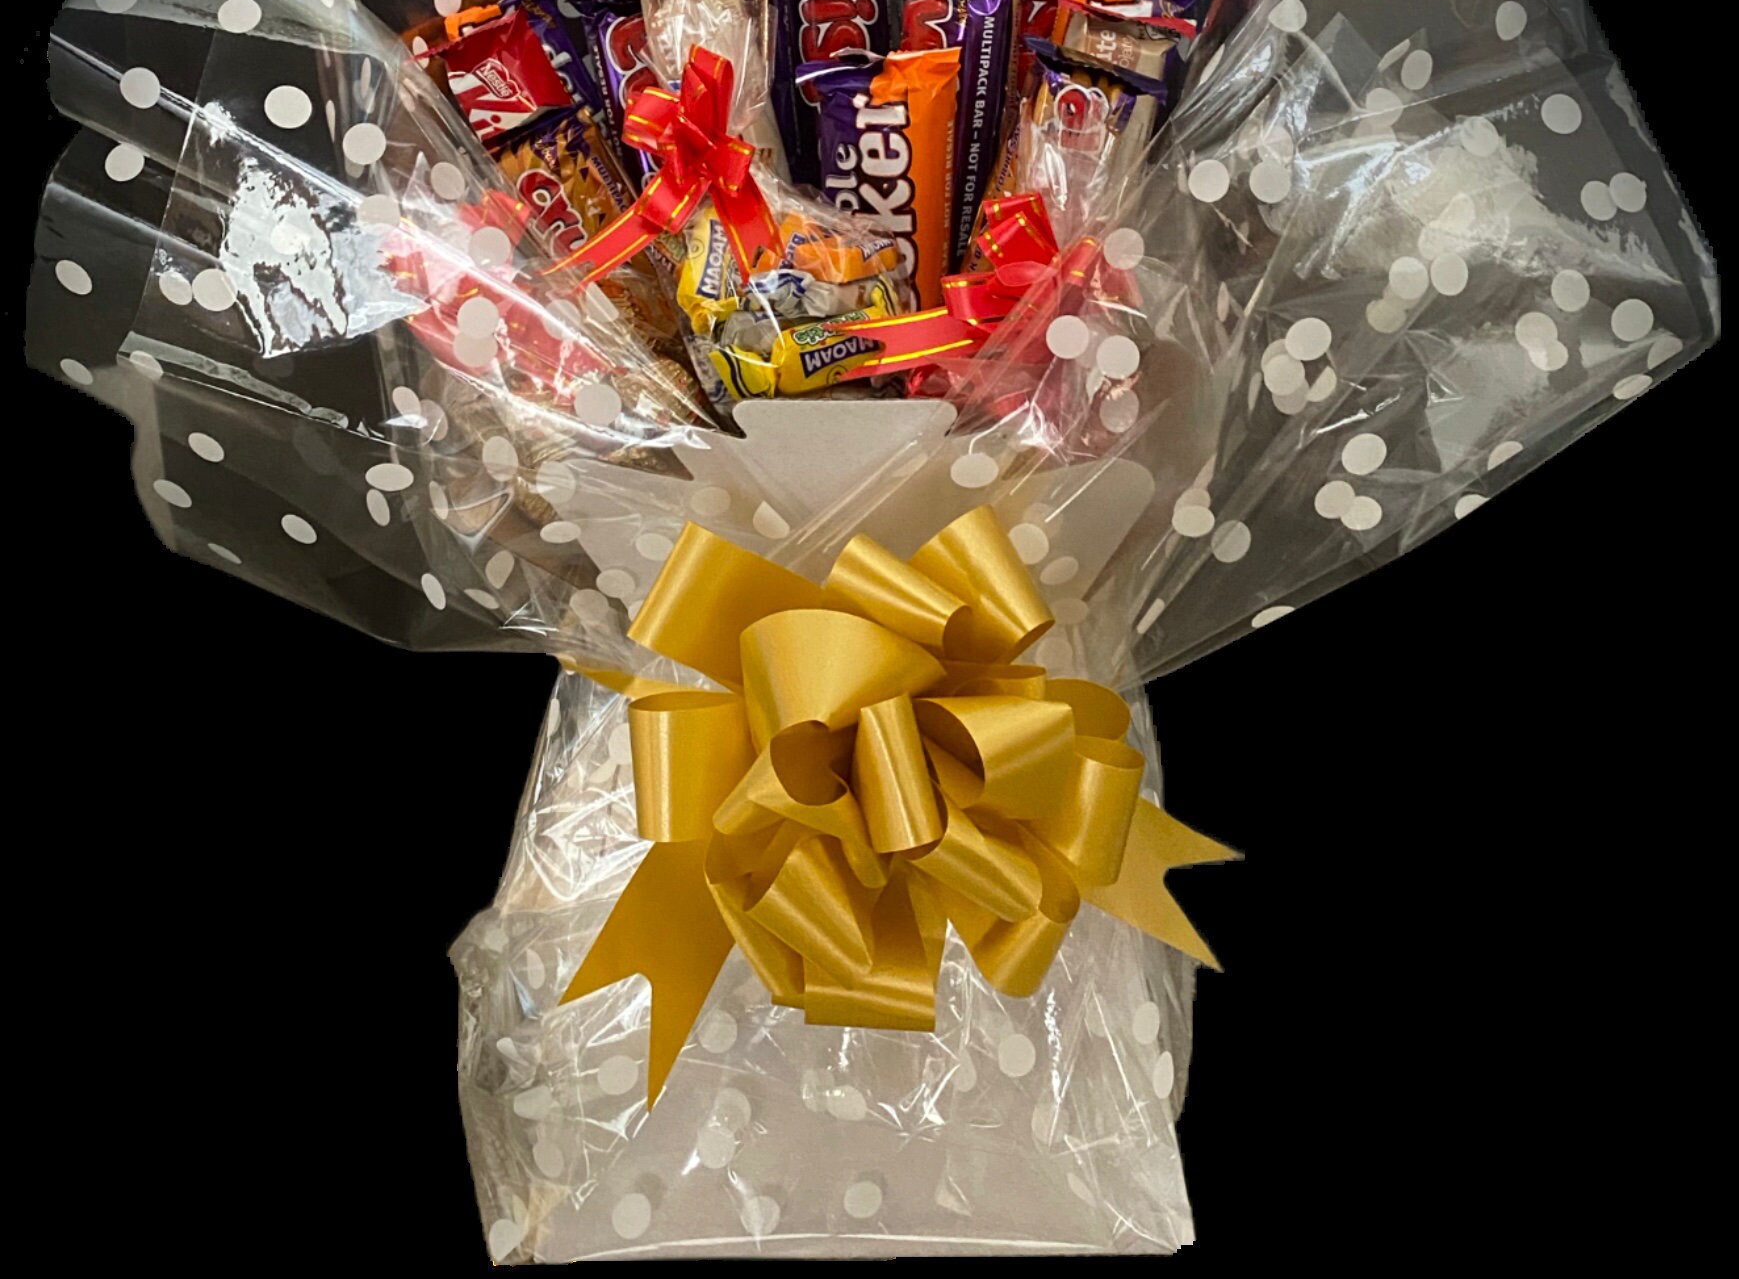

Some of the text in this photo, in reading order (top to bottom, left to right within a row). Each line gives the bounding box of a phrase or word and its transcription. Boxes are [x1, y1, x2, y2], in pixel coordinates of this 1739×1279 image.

[976, 15, 996, 97] MULTIPACK
[972, 100, 986, 128] BAR
[966, 142, 981, 171] NOT
[963, 174, 978, 203] FOR
[956, 205, 971, 258] RESALE
[701, 223, 729, 296] MAOAM
[803, 336, 875, 370] MAOAM
